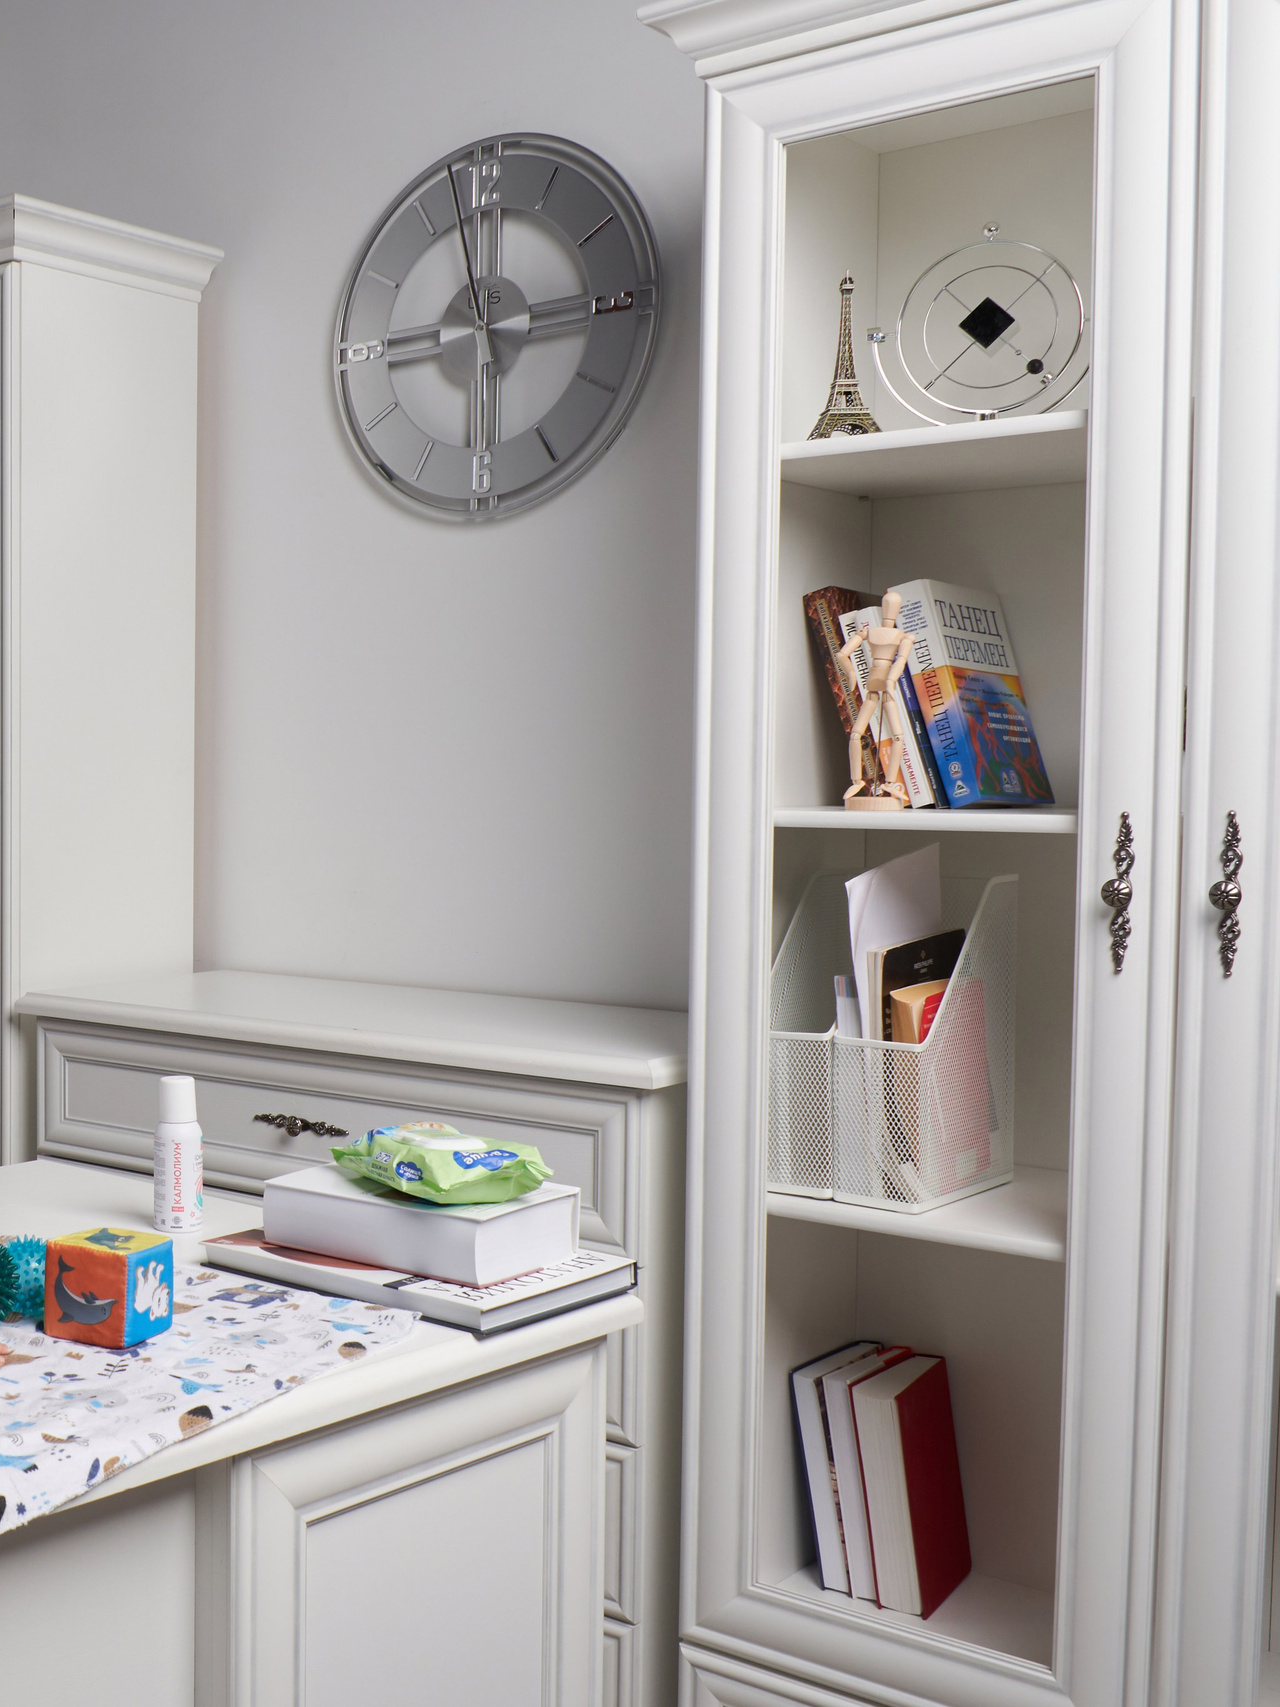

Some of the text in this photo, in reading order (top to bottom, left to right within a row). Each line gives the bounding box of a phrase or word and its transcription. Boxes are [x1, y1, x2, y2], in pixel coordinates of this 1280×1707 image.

[468, 158, 502, 208] 12
[472, 450, 492, 493] 6
[934, 599, 1003, 642] ТАНЕЦ
[913, 638, 944, 709] ПЕРЕМЕН
[943, 635, 1010, 668] ПЕРЕМЕН
[933, 709, 959, 762] ТАНЕЦ
[173, 1142, 182, 1205] КАЛМОЛИУМ
